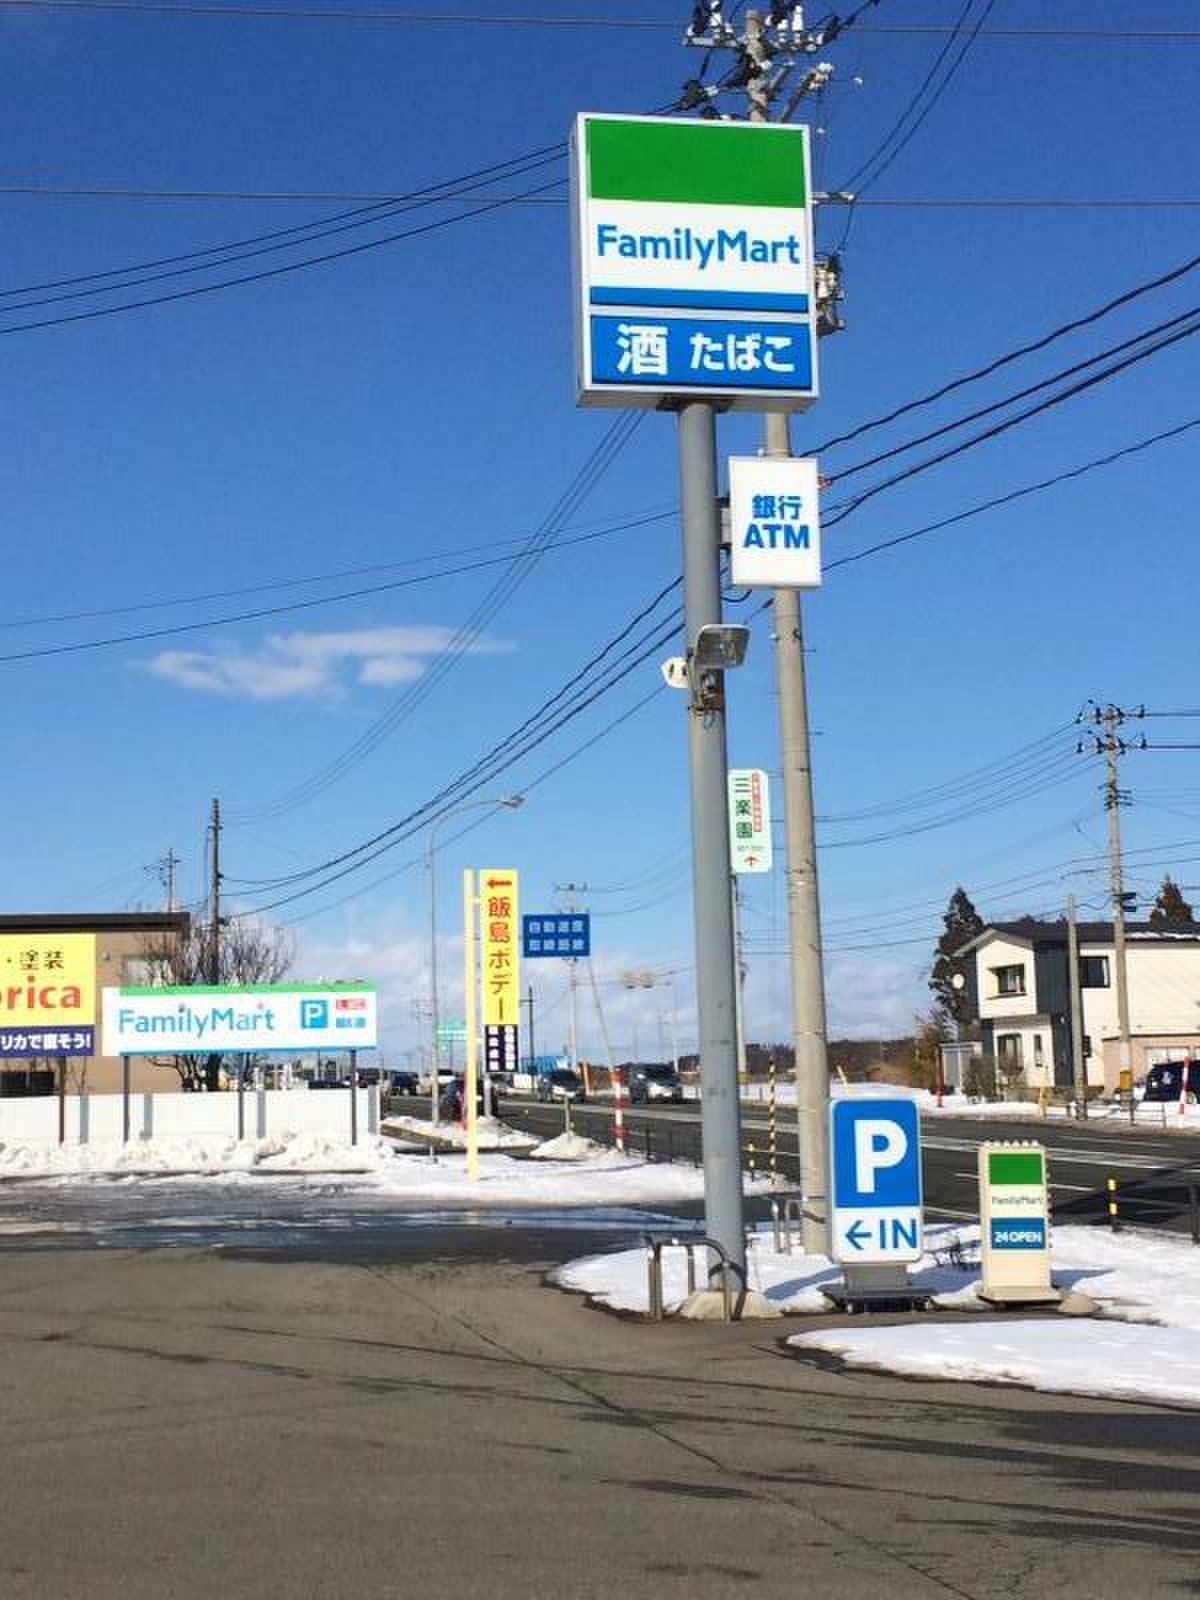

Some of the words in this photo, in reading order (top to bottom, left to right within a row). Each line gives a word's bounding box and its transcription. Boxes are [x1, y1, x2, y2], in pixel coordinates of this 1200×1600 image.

[597, 224, 800, 270] FamilyMart
[616, 323, 669, 375] 酒
[690, 332, 795, 373] たばこ
[752, 494, 802, 520] 銀行
[743, 524, 809, 548] ATM
[0, 975, 81, 1009] rica
[119, 1006, 275, 1038] FamilyMart
[853, 1119, 908, 1193] P
[880, 1218, 918, 1249] IN
